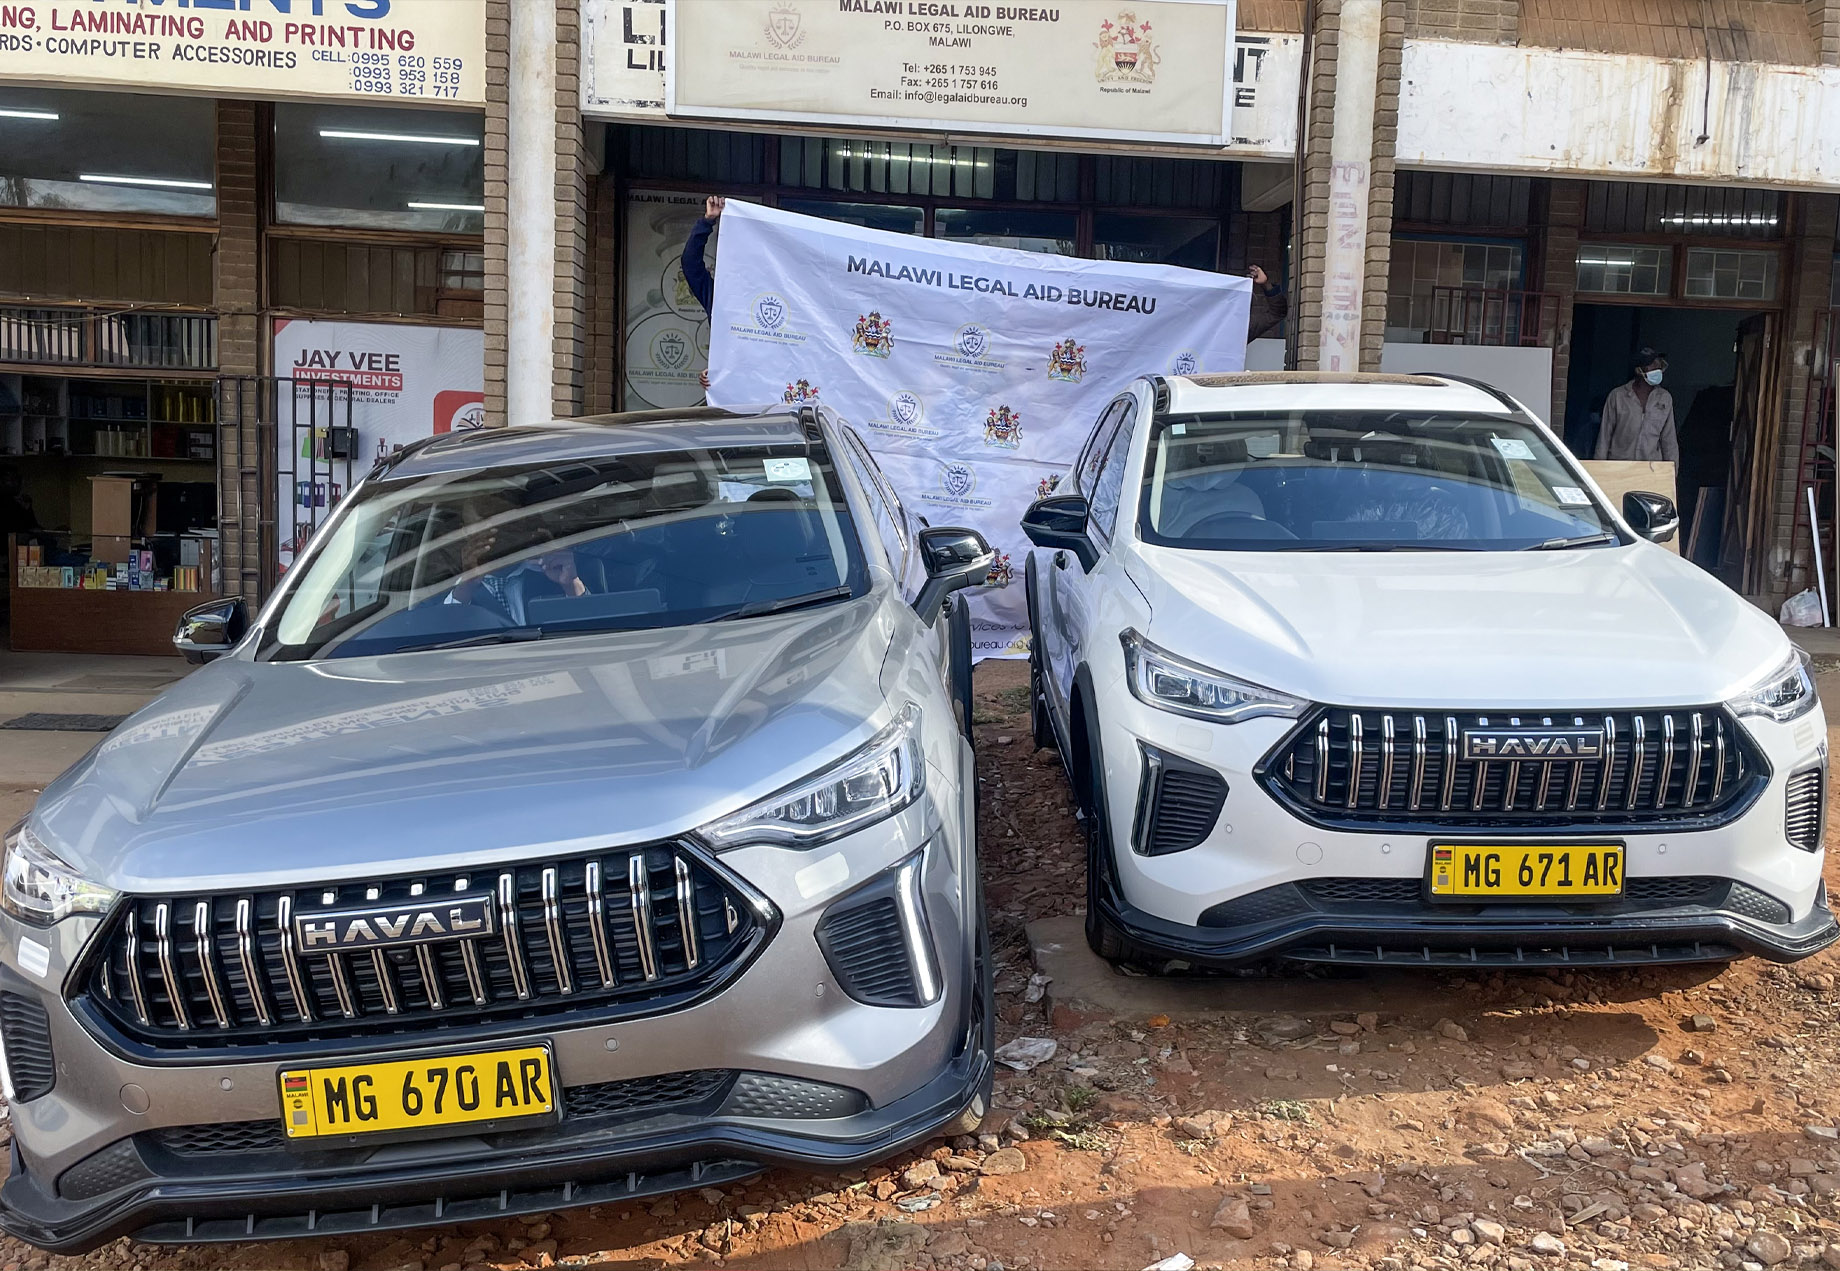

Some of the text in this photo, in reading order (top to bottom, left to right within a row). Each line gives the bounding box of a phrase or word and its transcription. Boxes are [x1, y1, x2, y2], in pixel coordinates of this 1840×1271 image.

[840, 0, 1060, 22] MALAWI LEGAL AID BUREAU
[52, 8, 204, 39] LAMINATING
[225, 19, 272, 42] AND
[285, 22, 415, 51] PRINTING
[884, 21, 1015, 38] P.O. BOX 675, LILONGWE,
[929, 36, 971, 48] MALAWI
[172, 43, 297, 68] ACCESSORIES
[398, 56, 425, 68] 620
[433, 57, 463, 71] 559
[729, 51, 761, 59] MALAWI
[764, 53, 790, 61] LEGAL
[808, 55, 840, 63] BUREAU
[399, 69, 426, 83] 953
[433, 72, 460, 85] 158
[903, 63, 920, 73] Tel:
[924, 64, 947, 75] +265
[959, 65, 976, 76] 753
[979, 66, 997, 77] 945
[399, 83, 424, 96] 321
[434, 85, 460, 98] 717
[901, 77, 922, 87] Fax:
[925, 78, 949, 89] +265
[960, 79, 977, 89] 757
[980, 80, 998, 90] 616
[870, 88, 1028, 107] Email: info@legalaidbureau.org
[668, 197, 698, 205] LEGAL
[847, 255, 1156, 315] MALAWI LEGAL AID BUREAU
[731, 325, 753, 333] MALAWI
[784, 333, 806, 341] BUREAU
[294, 349, 400, 372] JAY VEE
[295, 371, 400, 387] INVESTMENTS
[1472, 737, 1598, 754] HAVAL
[1464, 852, 1619, 887] MG 671 AR
[305, 908, 482, 945] HAVAL
[323, 1057, 547, 1124] MG 670 AR
